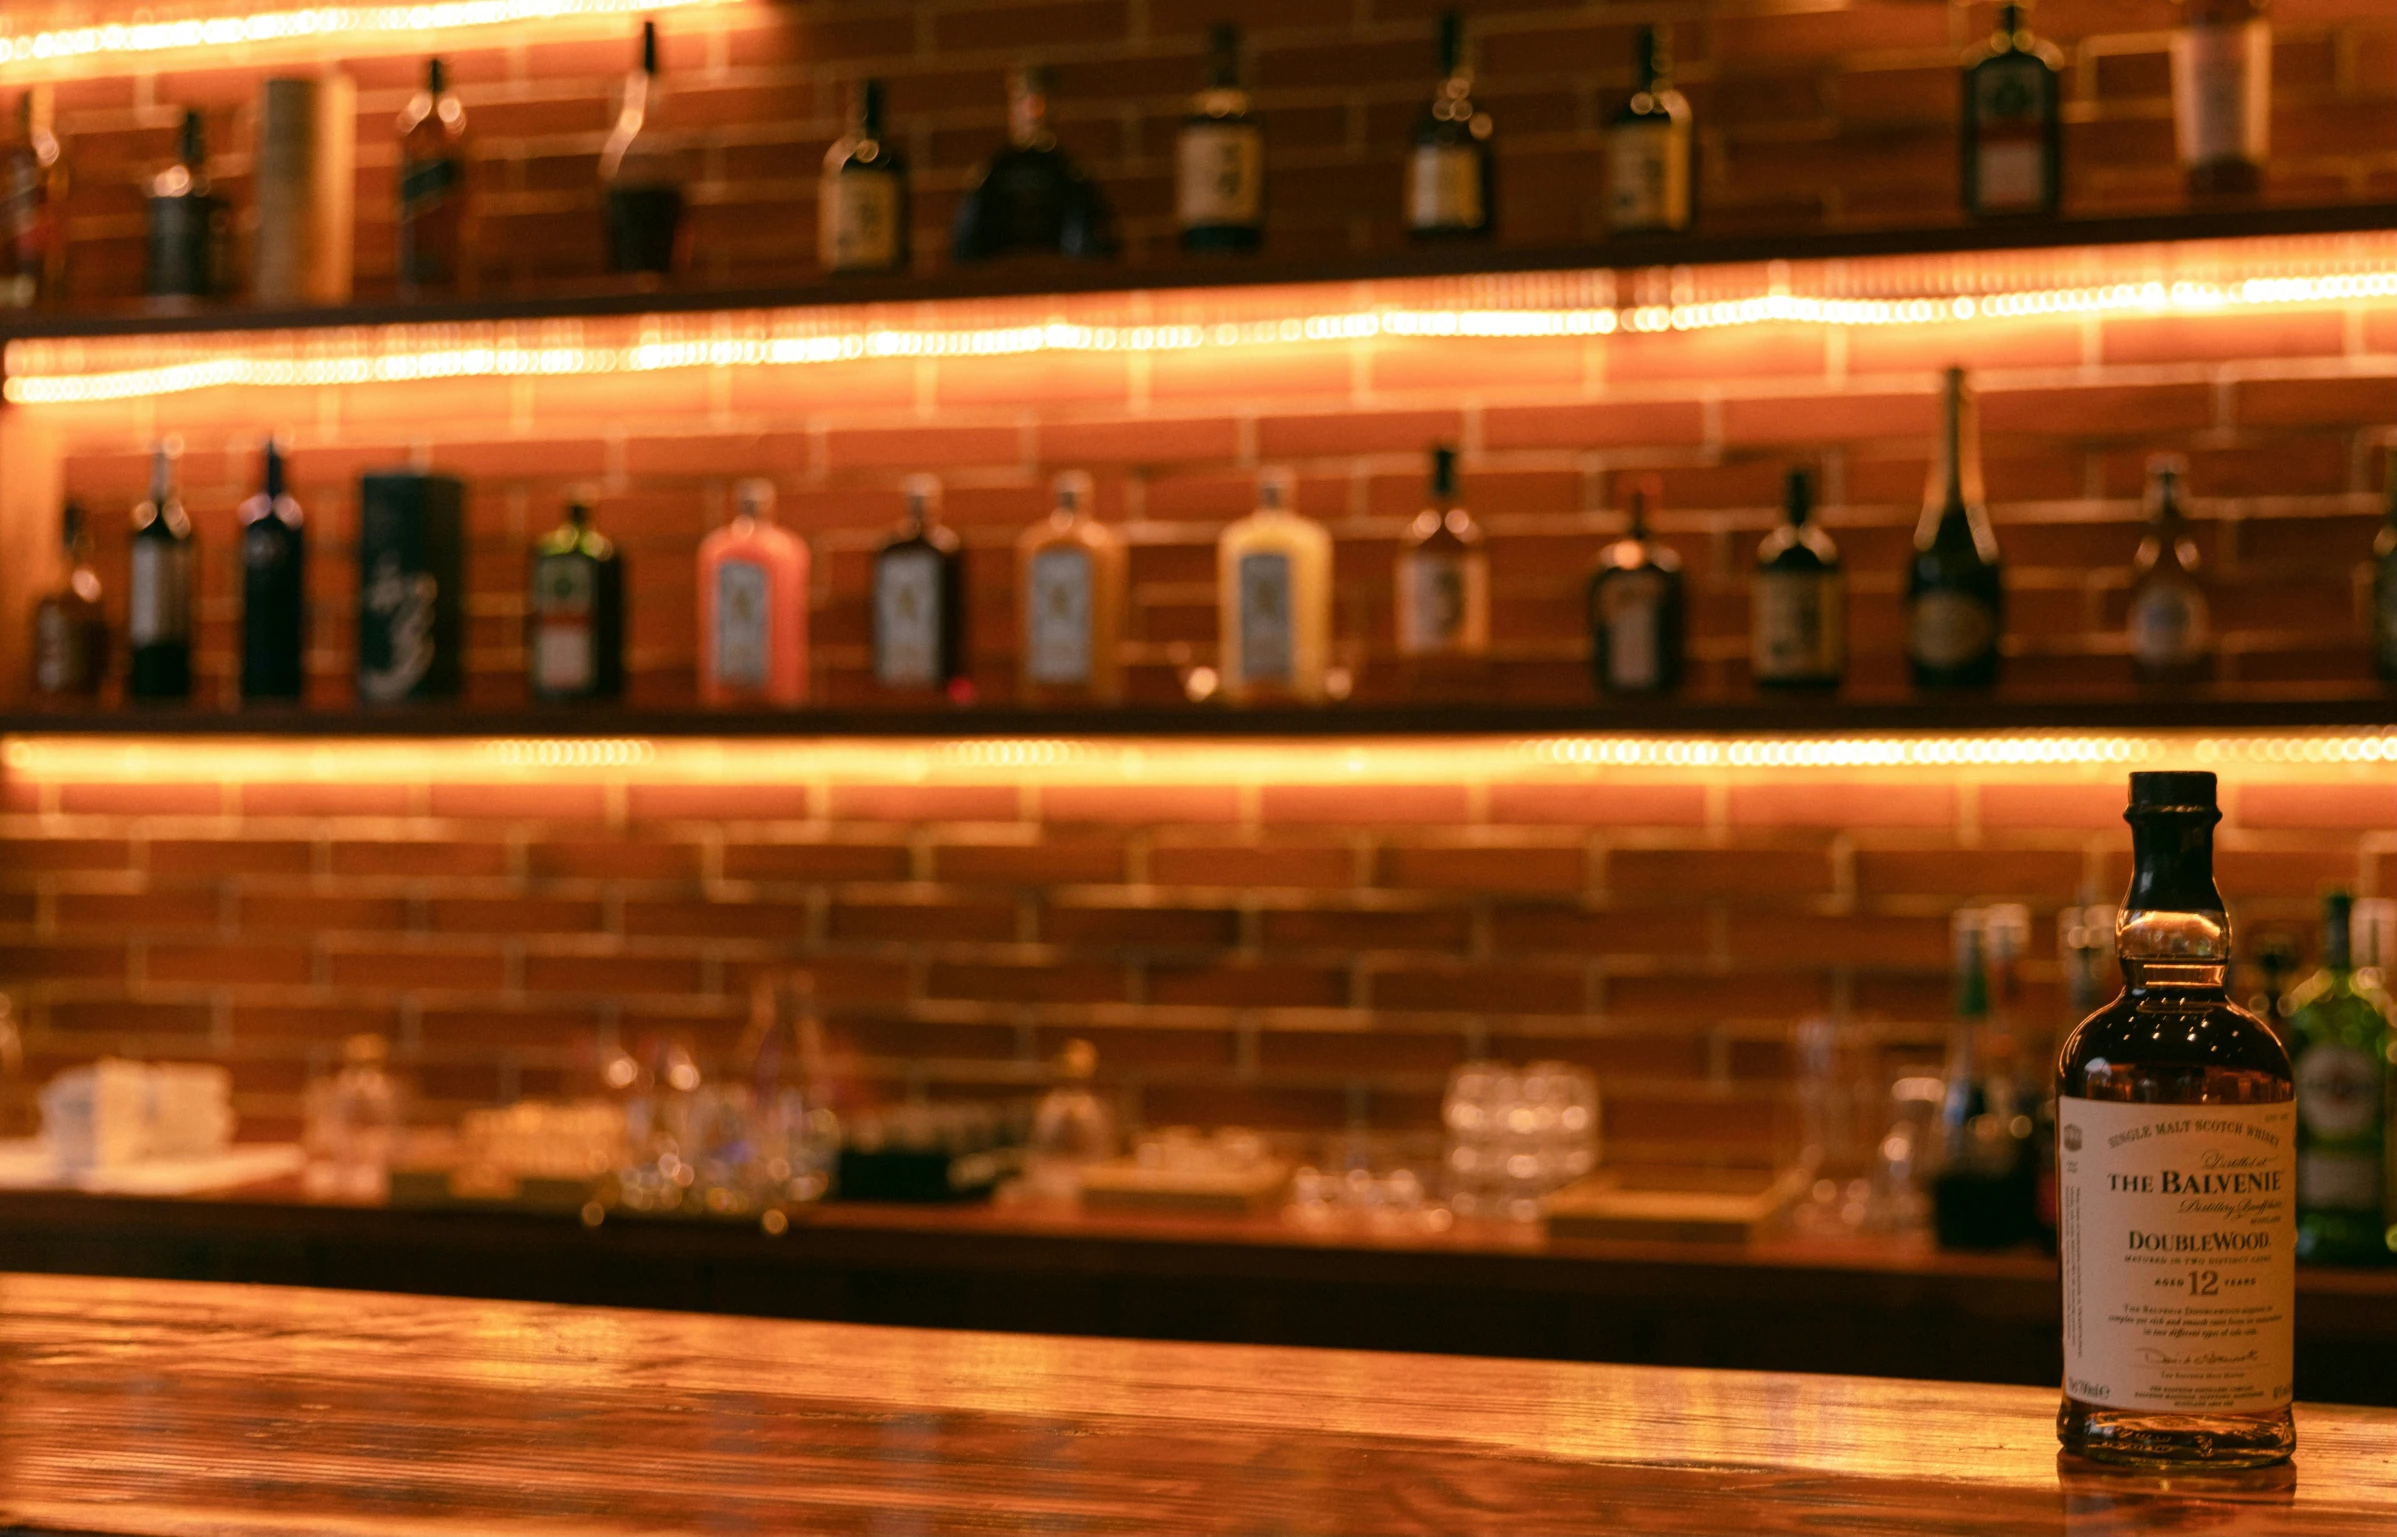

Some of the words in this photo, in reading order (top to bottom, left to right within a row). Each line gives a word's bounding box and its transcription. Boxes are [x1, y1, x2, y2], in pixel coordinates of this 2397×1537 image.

[2107, 1121, 2152, 1149] SINGLE
[2155, 1119, 2191, 1136] MALT
[2194, 1118, 2244, 1136] SCOTCH
[2246, 1124, 2281, 1149] WHISKY
[2200, 1149, 2255, 1169] Distilled
[2106, 1172, 2155, 1194] THE
[2160, 1169, 2283, 1195] BALVENIE
[2177, 1198, 2237, 1219] Distillery
[2123, 1254, 2168, 1265] MATURED
[2169, 1256, 2181, 1265] IN
[2182, 1256, 2205, 1266] TWO
[2207, 1255, 2249, 1265] DISTINCT
[2154, 1278, 2185, 1288] AGED
[2187, 1269, 2219, 1297] 12
[2224, 1277, 2257, 1288] YEARS
[2165, 1316, 2181, 1326] and
[2168, 1326, 2201, 1339] different
